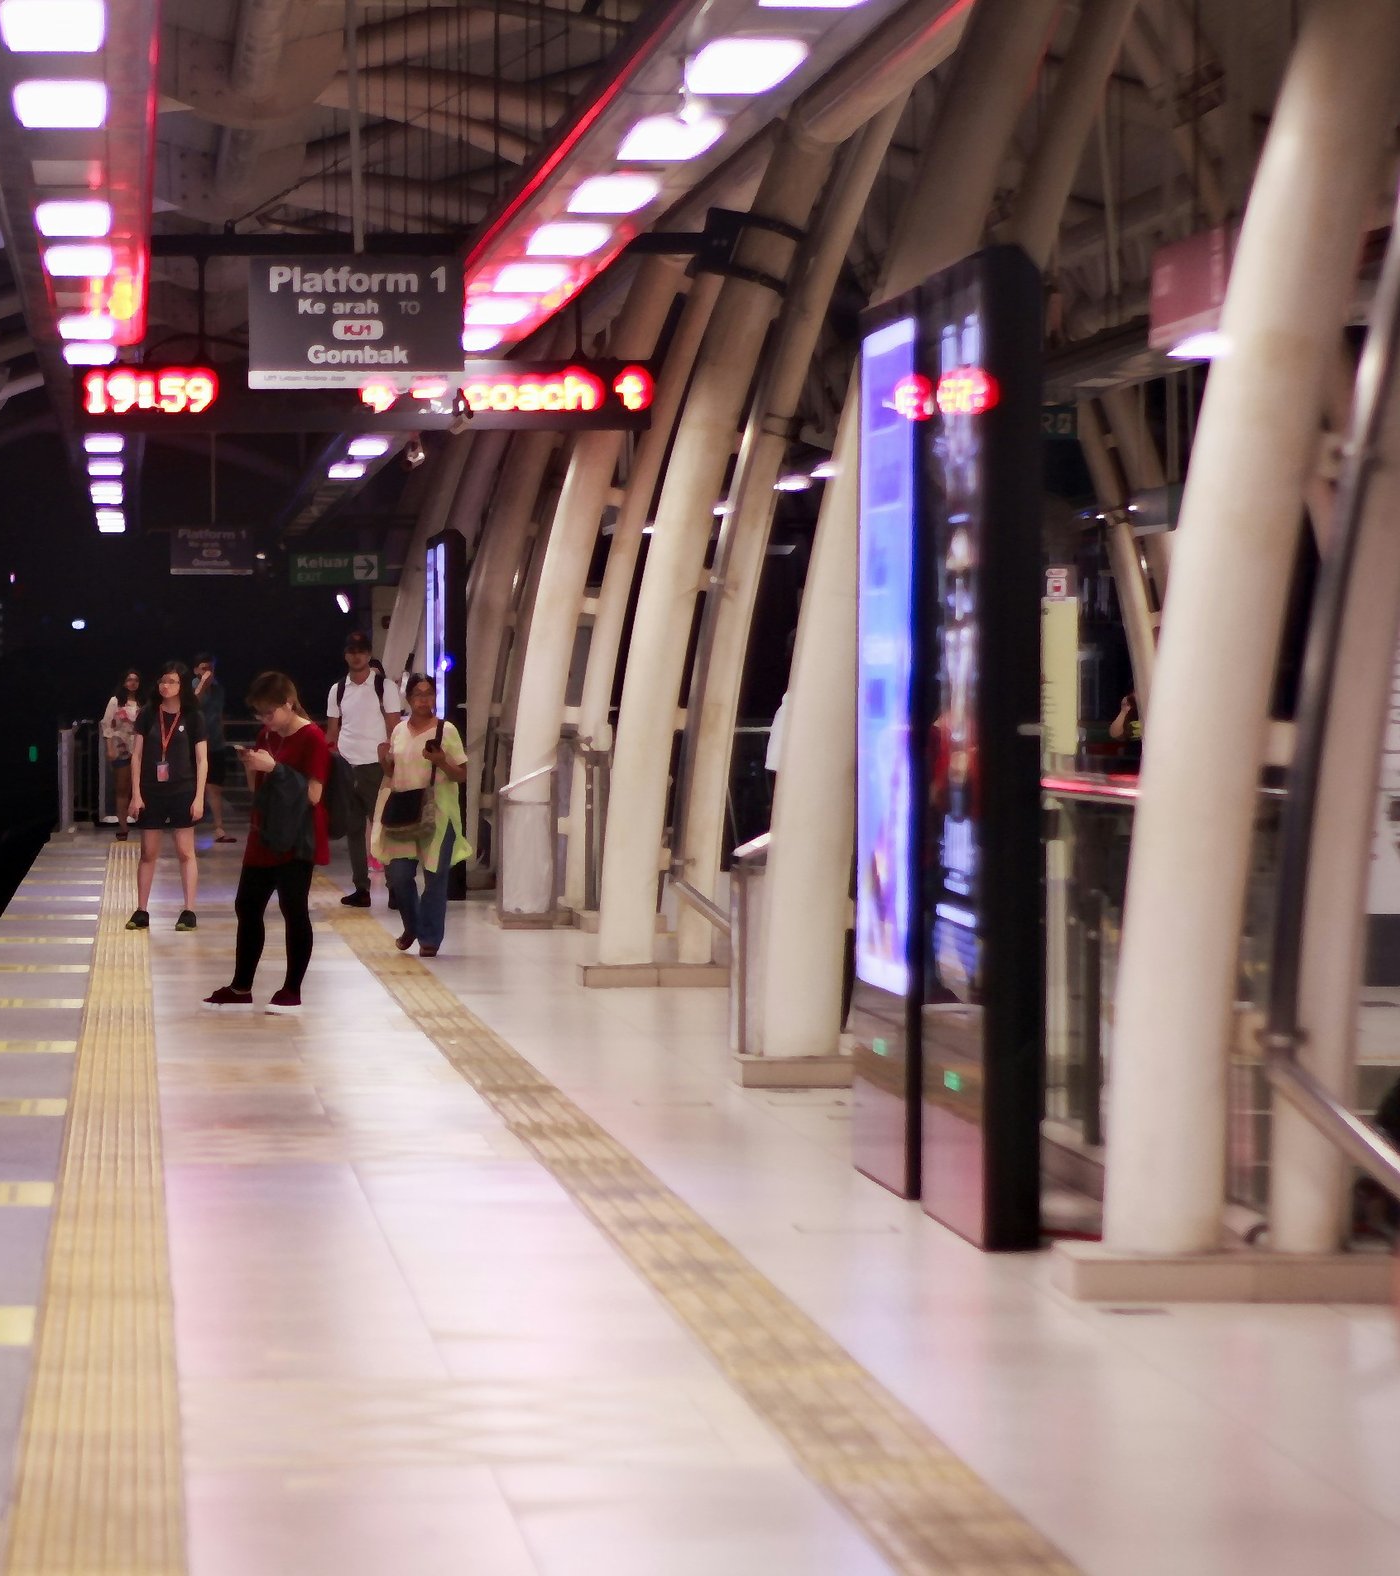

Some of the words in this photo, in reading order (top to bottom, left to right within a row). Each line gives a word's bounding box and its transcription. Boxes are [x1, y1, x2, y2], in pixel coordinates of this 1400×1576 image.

[268, 265, 419, 293] Platform
[429, 265, 447, 293] 1
[297, 298, 327, 315] Ke
[331, 299, 379, 315] arah
[399, 301, 421, 315] TO
[343, 324, 371, 336] KJ1
[306, 344, 409, 364] Gombak
[85, 373, 215, 414] 19:59
[462, 374, 597, 412] coach
[177, 528, 236, 540] Platform
[296, 555, 350, 569] Keluar
